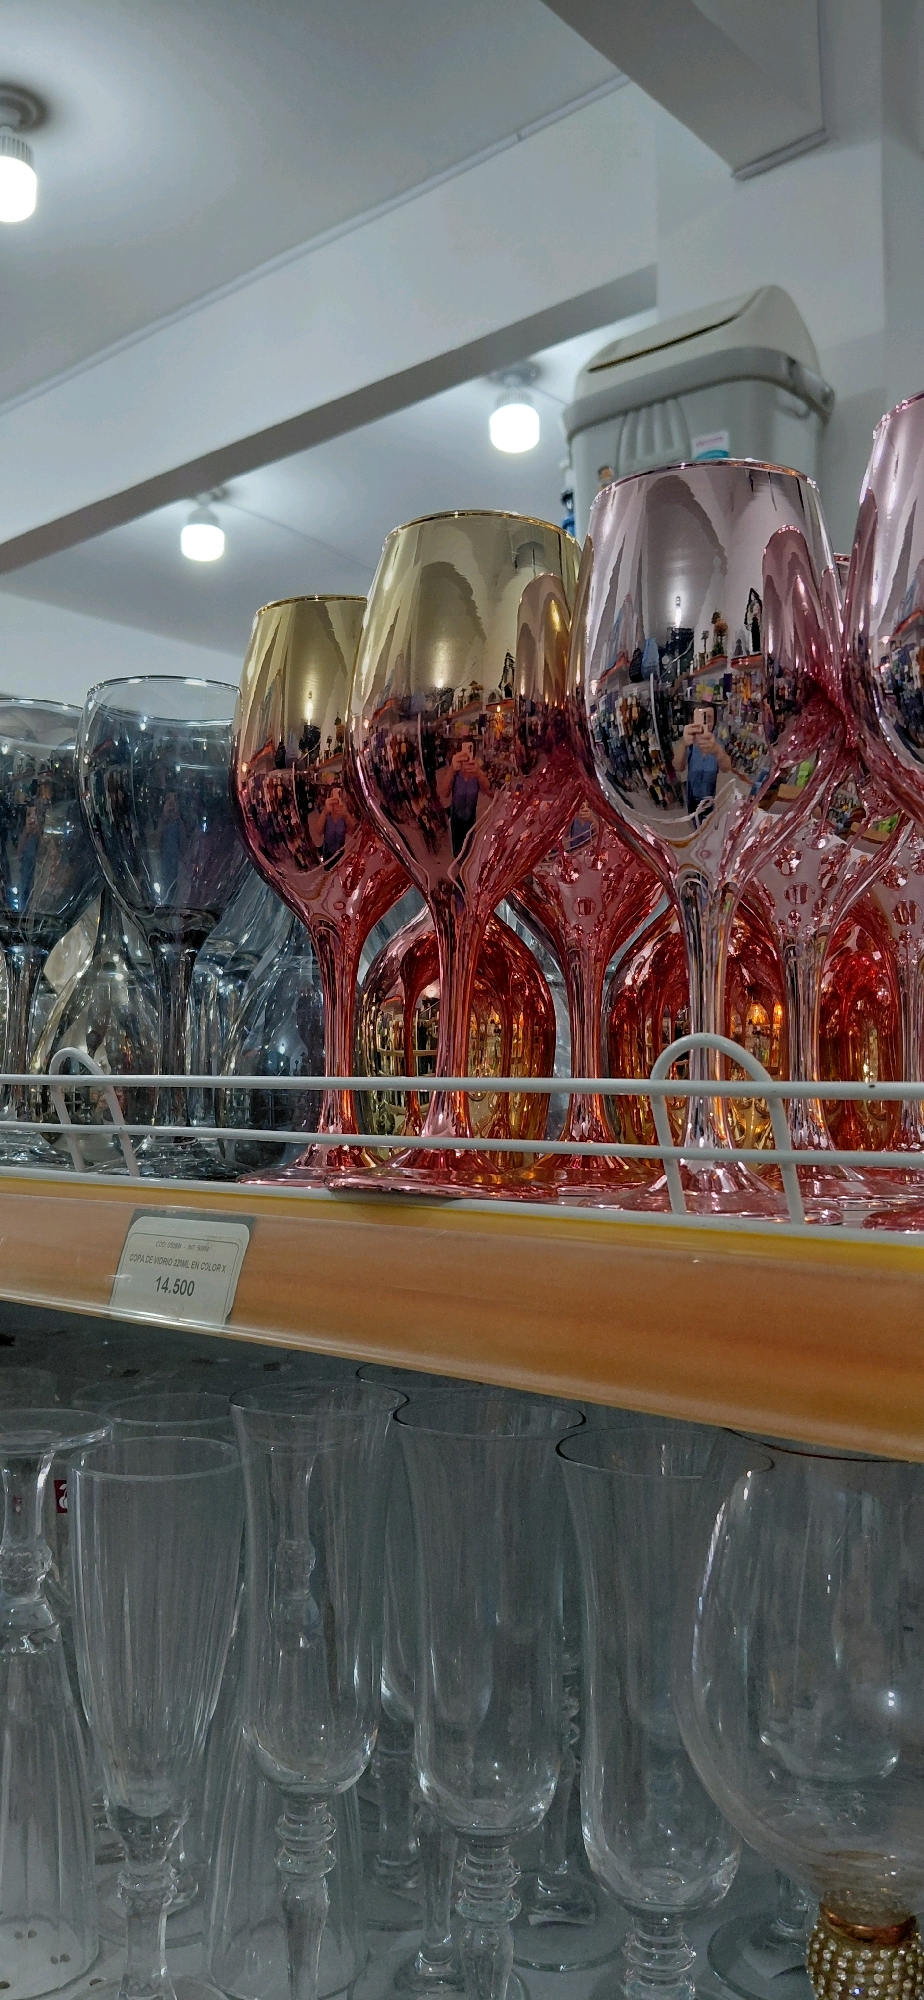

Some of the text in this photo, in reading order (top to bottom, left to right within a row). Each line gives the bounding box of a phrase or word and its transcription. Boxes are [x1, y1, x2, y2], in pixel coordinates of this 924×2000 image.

[129, 1253, 228, 1273] COPA DE VIDRIO 220ML EN COLOR X
[155, 1276, 195, 1297] 14.500
